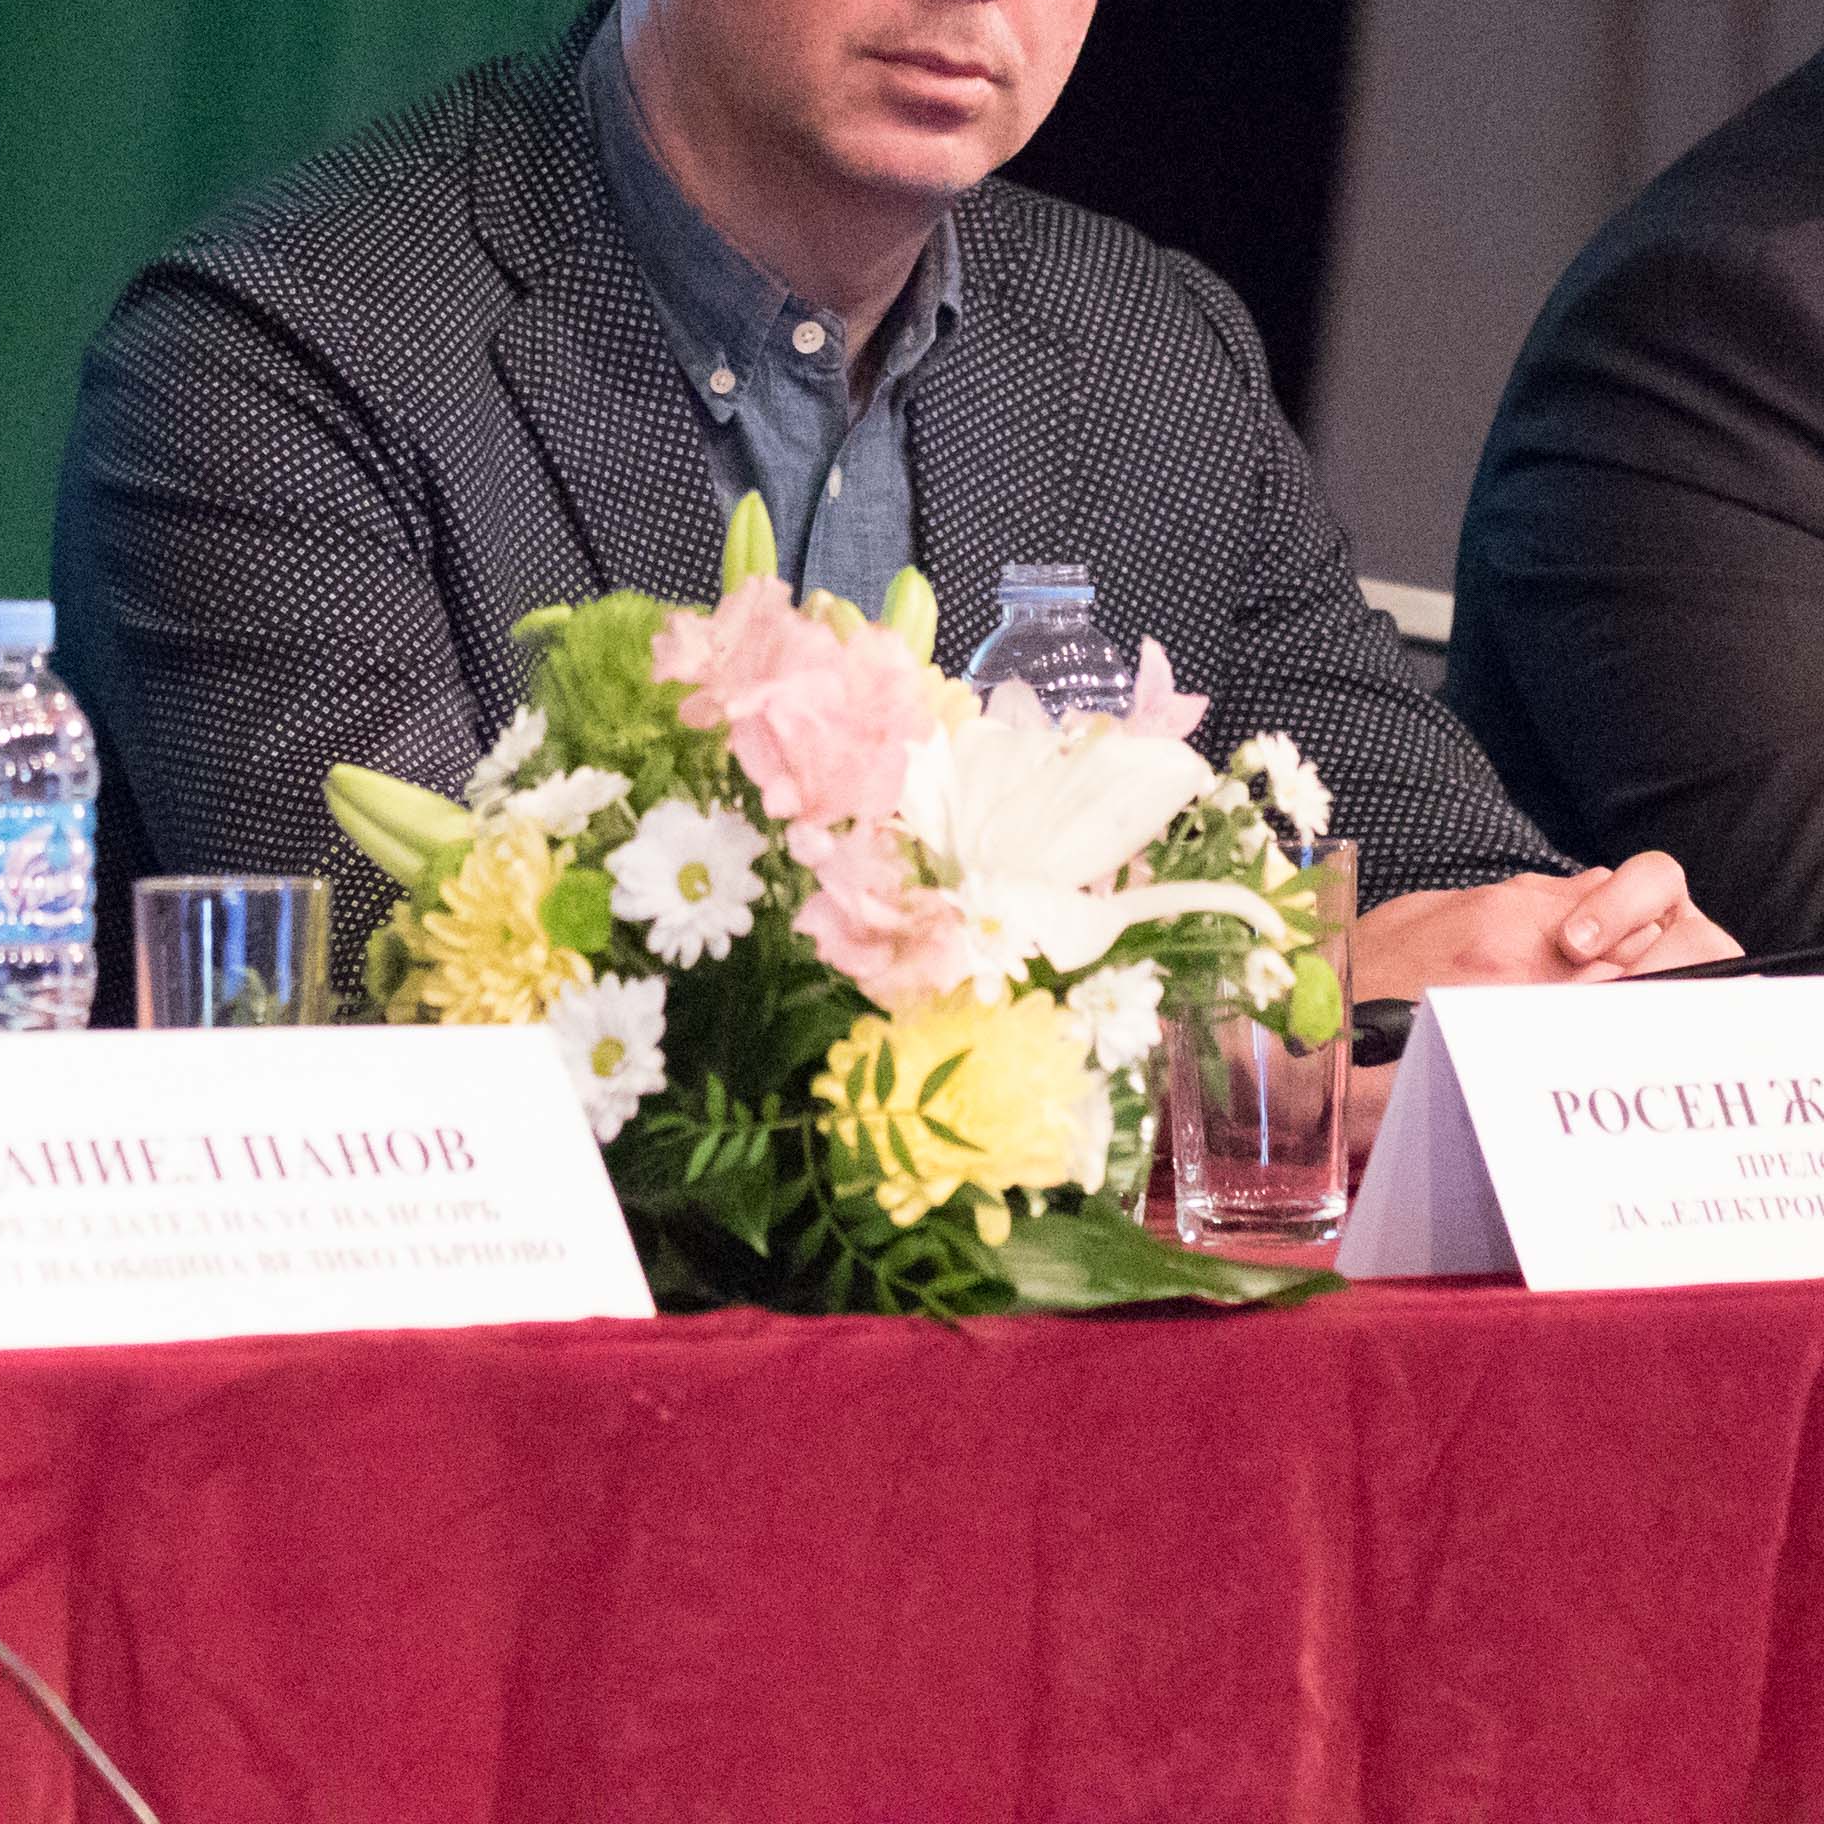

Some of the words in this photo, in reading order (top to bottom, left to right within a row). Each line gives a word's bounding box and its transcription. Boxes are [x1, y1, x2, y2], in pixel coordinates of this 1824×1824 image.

[1549, 1079, 1760, 1138] РОСЕН
[241, 1126, 477, 1182] ПАНОВ
[1608, 1202, 1650, 1233] ДА
